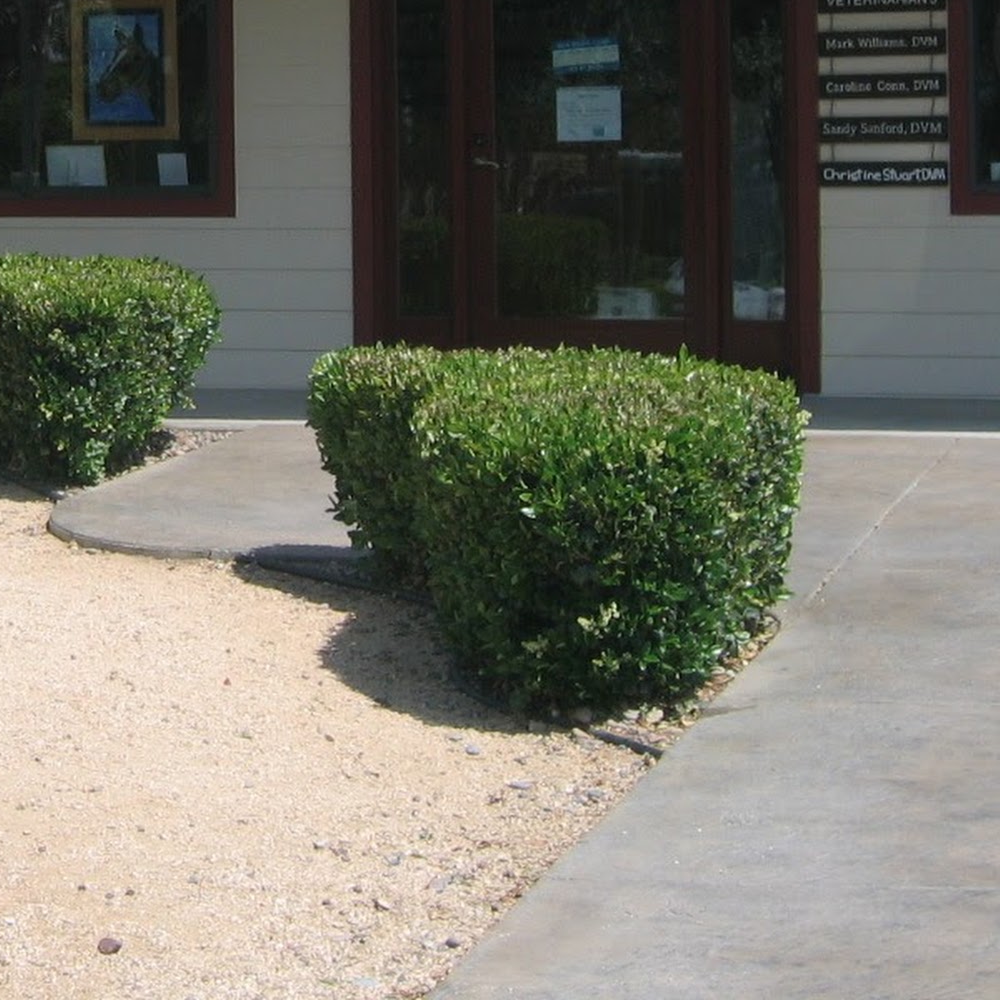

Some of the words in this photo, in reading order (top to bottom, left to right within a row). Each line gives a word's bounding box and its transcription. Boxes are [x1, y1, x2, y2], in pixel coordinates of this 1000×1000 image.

[826, 38, 855, 50] Mark
[911, 35, 938, 48] DVM
[913, 78, 940, 92] DVM
[823, 123, 858, 137] Sandy
[910, 121, 943, 135] DVM
[823, 166, 882, 182] Christine
